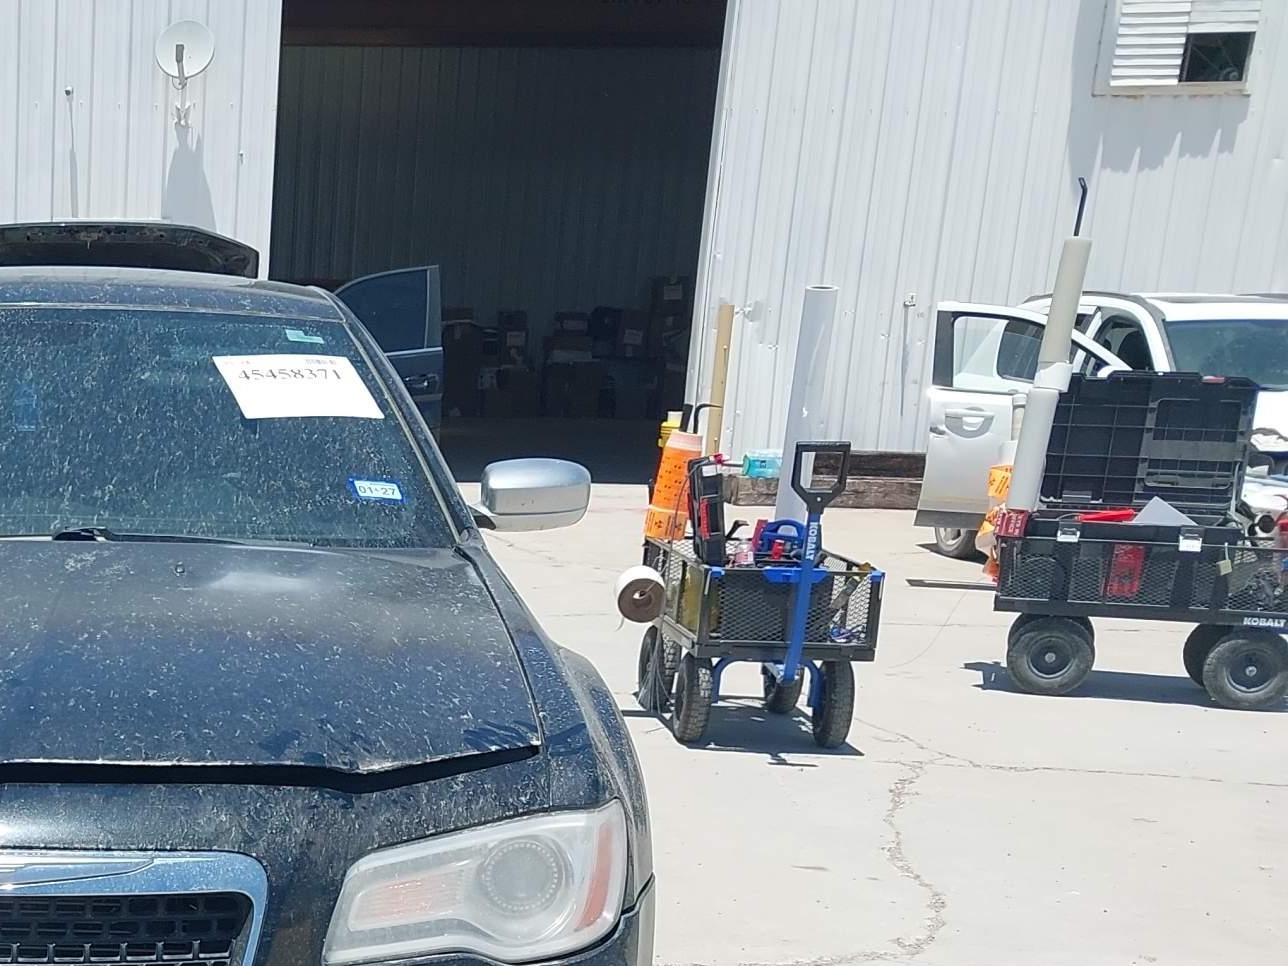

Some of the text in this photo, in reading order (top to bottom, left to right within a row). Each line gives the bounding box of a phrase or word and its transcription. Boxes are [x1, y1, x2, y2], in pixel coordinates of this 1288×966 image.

[238, 368, 342, 381] 45458371
[805, 521, 819, 561] KOBALT
[1243, 617, 1287, 627] KOBALT
